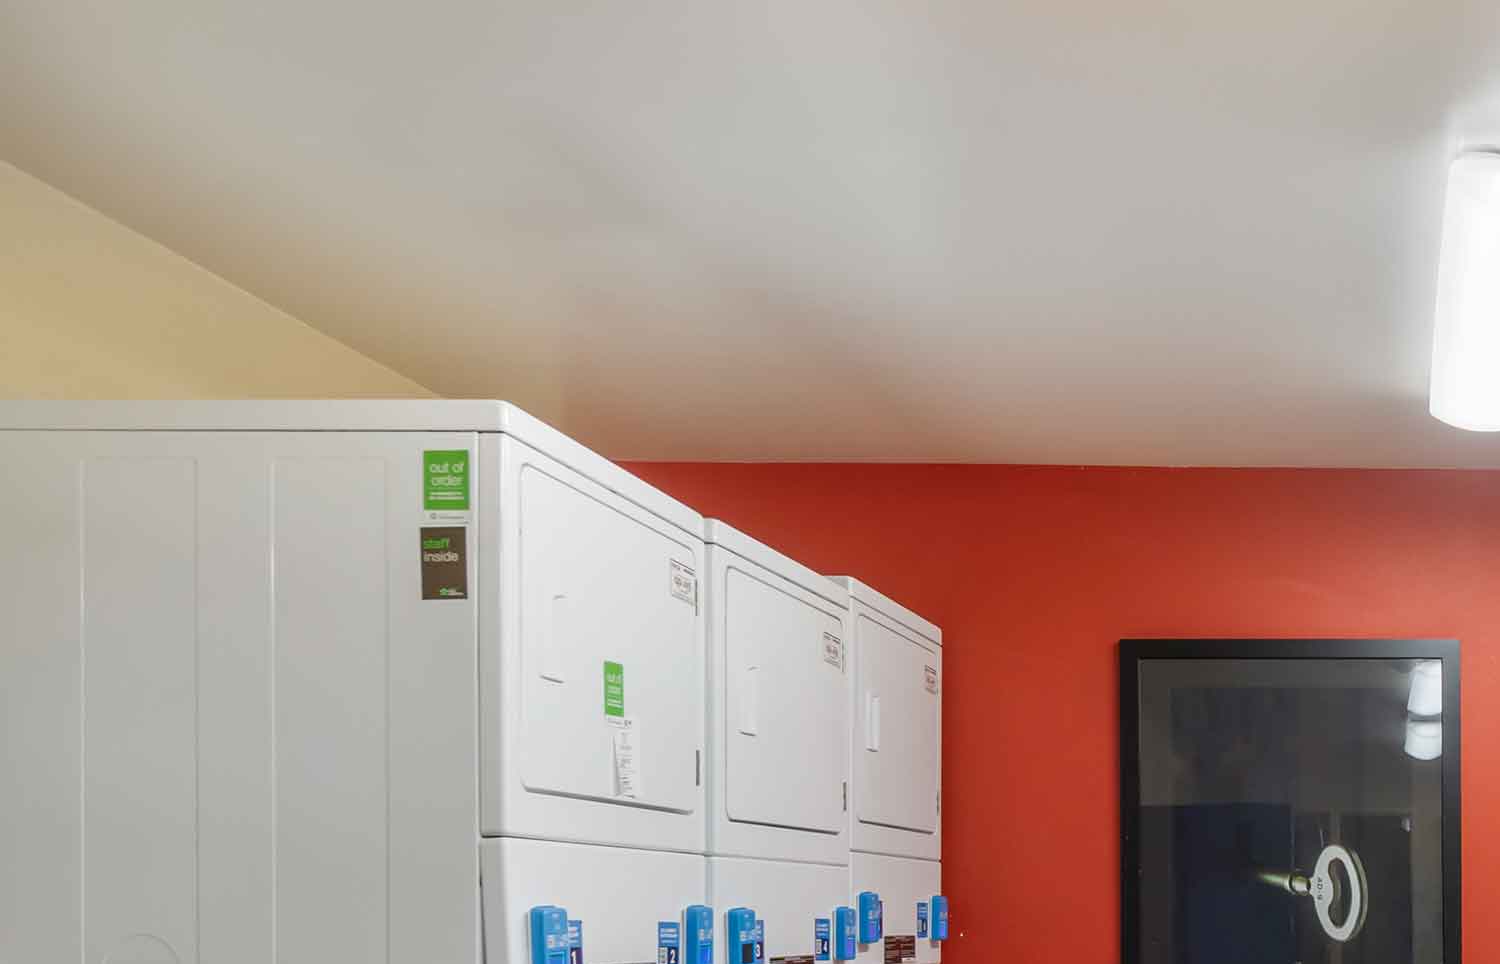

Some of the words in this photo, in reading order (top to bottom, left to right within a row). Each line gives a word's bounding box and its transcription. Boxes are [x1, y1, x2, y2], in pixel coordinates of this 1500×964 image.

[429, 462, 449, 473] out
[451, 461, 464, 473] of
[430, 475, 463, 486] order
[423, 538, 450, 549] staff
[423, 551, 459, 562] inside
[670, 949, 676, 964] 2
